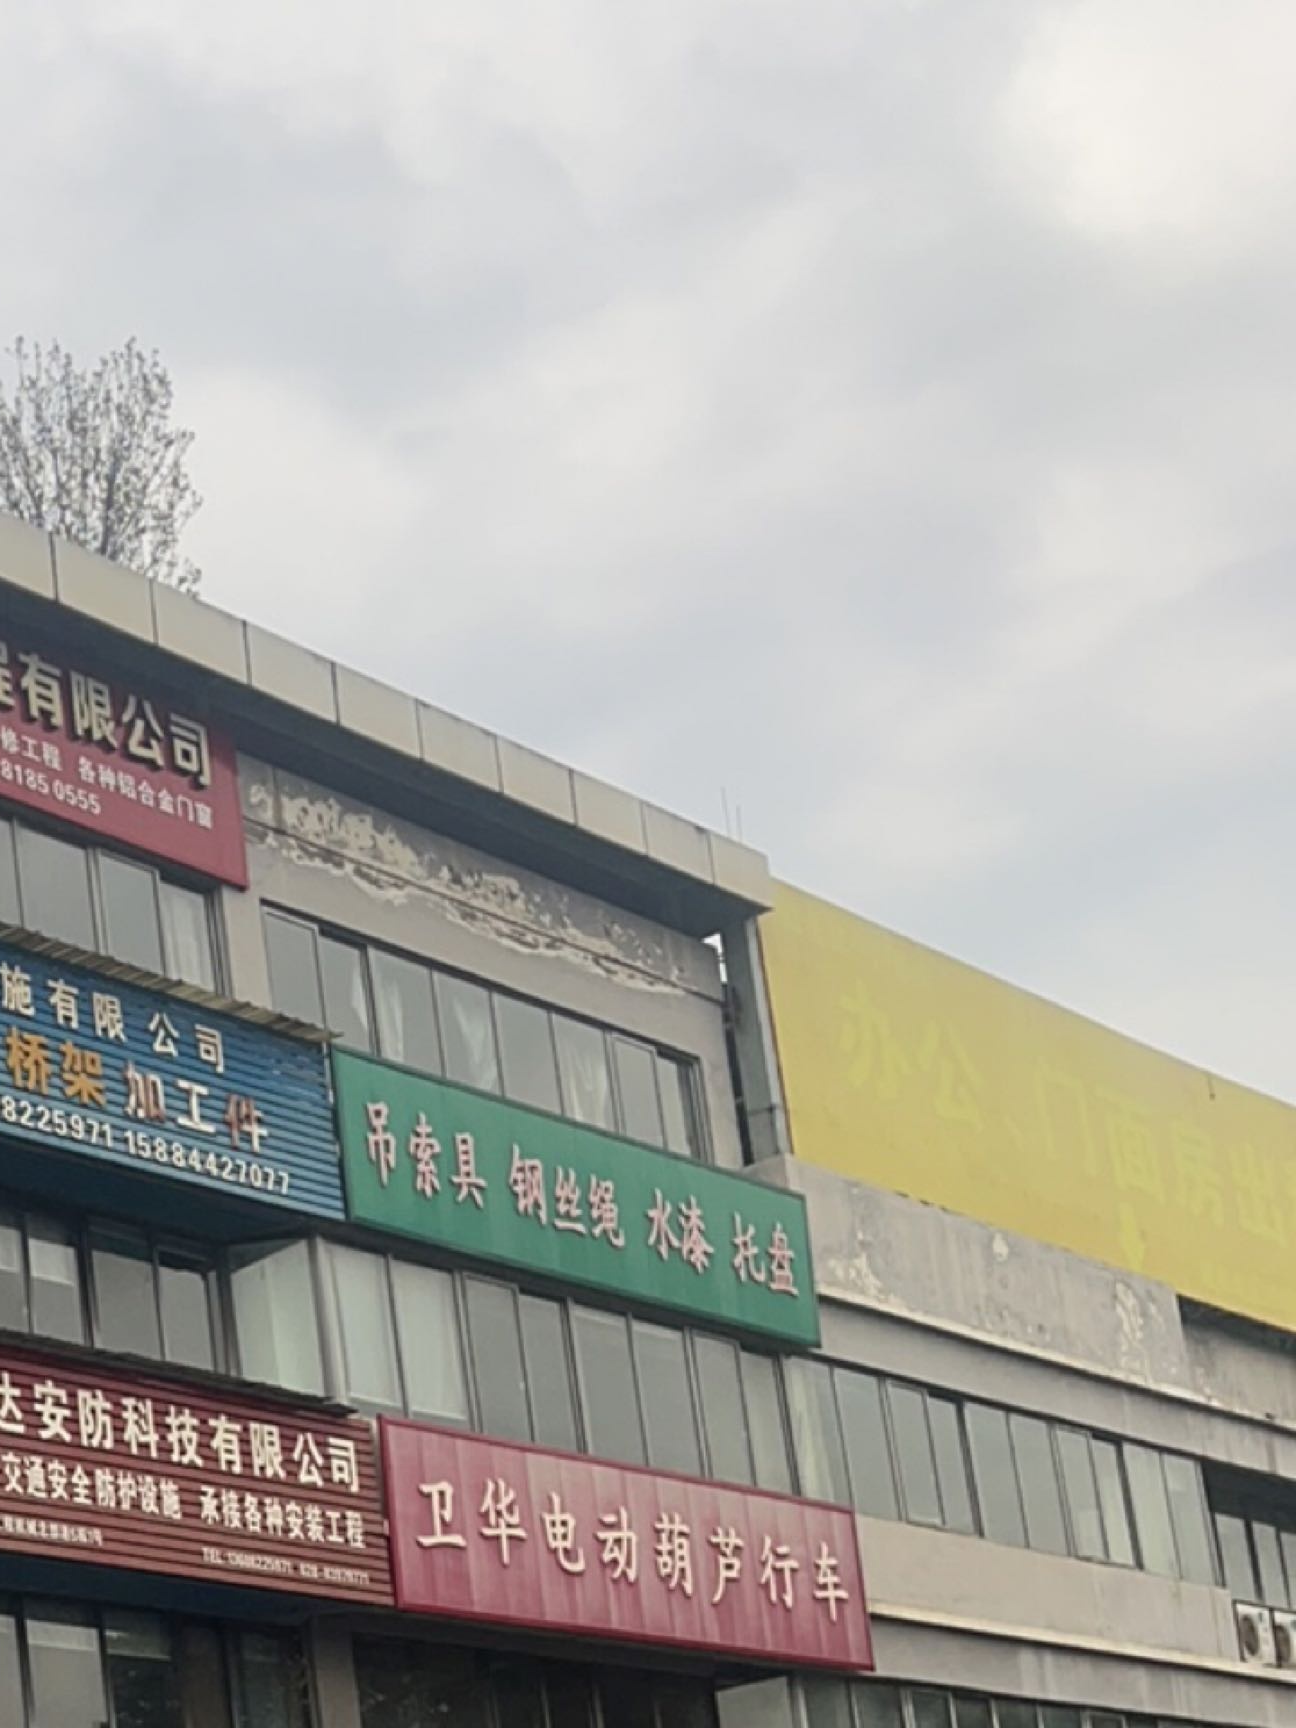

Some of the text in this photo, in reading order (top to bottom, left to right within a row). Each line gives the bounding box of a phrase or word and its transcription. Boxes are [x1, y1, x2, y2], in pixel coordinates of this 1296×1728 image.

[51, 780, 103, 816] 0555
[77, 755, 213, 830] 各种铝合金门窗
[123, 1130, 291, 1197] 15884427077
[366, 1101, 800, 1298] 吊索具 钢丝绳 水漆 托盘
[0, 1451, 182, 1521] 交通安全防护设施
[200, 1484, 367, 1549] 承接各种安装工程
[416, 1477, 849, 1622] 卫华电动葫芦行车
